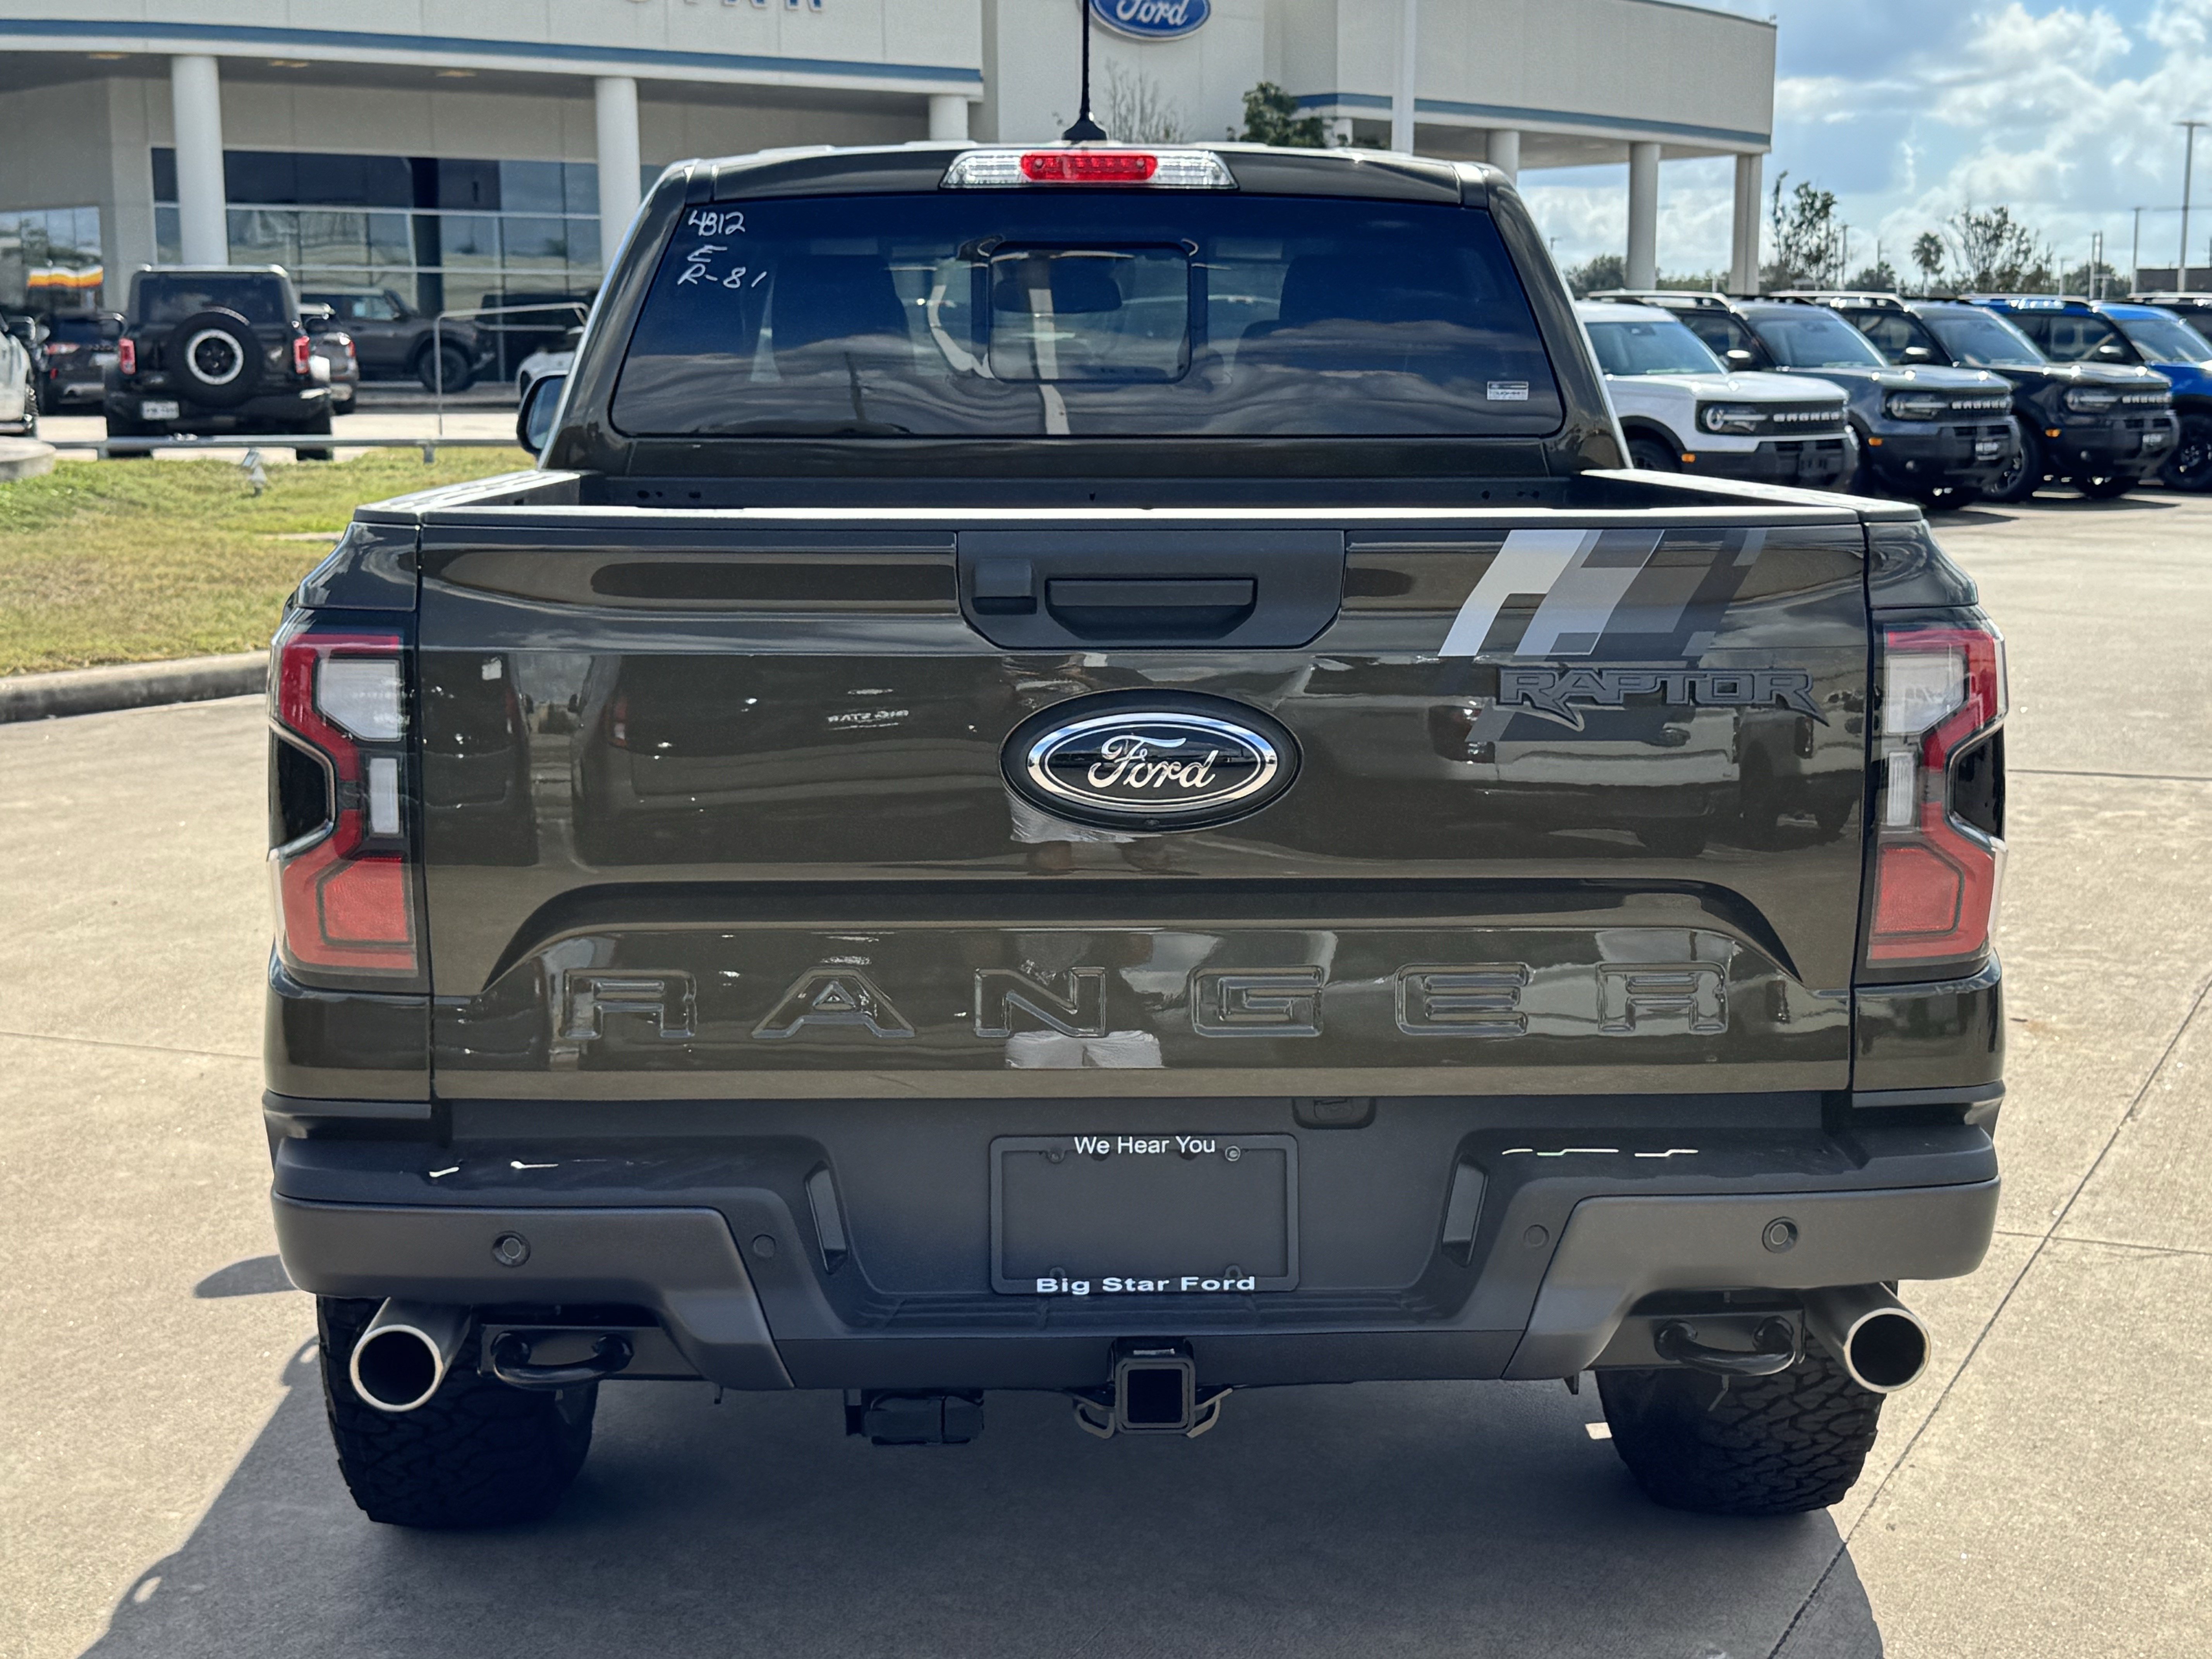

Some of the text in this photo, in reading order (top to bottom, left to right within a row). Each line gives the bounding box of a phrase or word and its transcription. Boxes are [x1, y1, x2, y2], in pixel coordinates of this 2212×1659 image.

[1496, 667, 1829, 730] RAPTOR
[1087, 734, 1220, 789] Ford
[563, 962, 1729, 1038] RANGER
[1074, 1136, 1215, 1154] We Hear You
[1036, 1276, 1255, 1295] Big Star Ford
